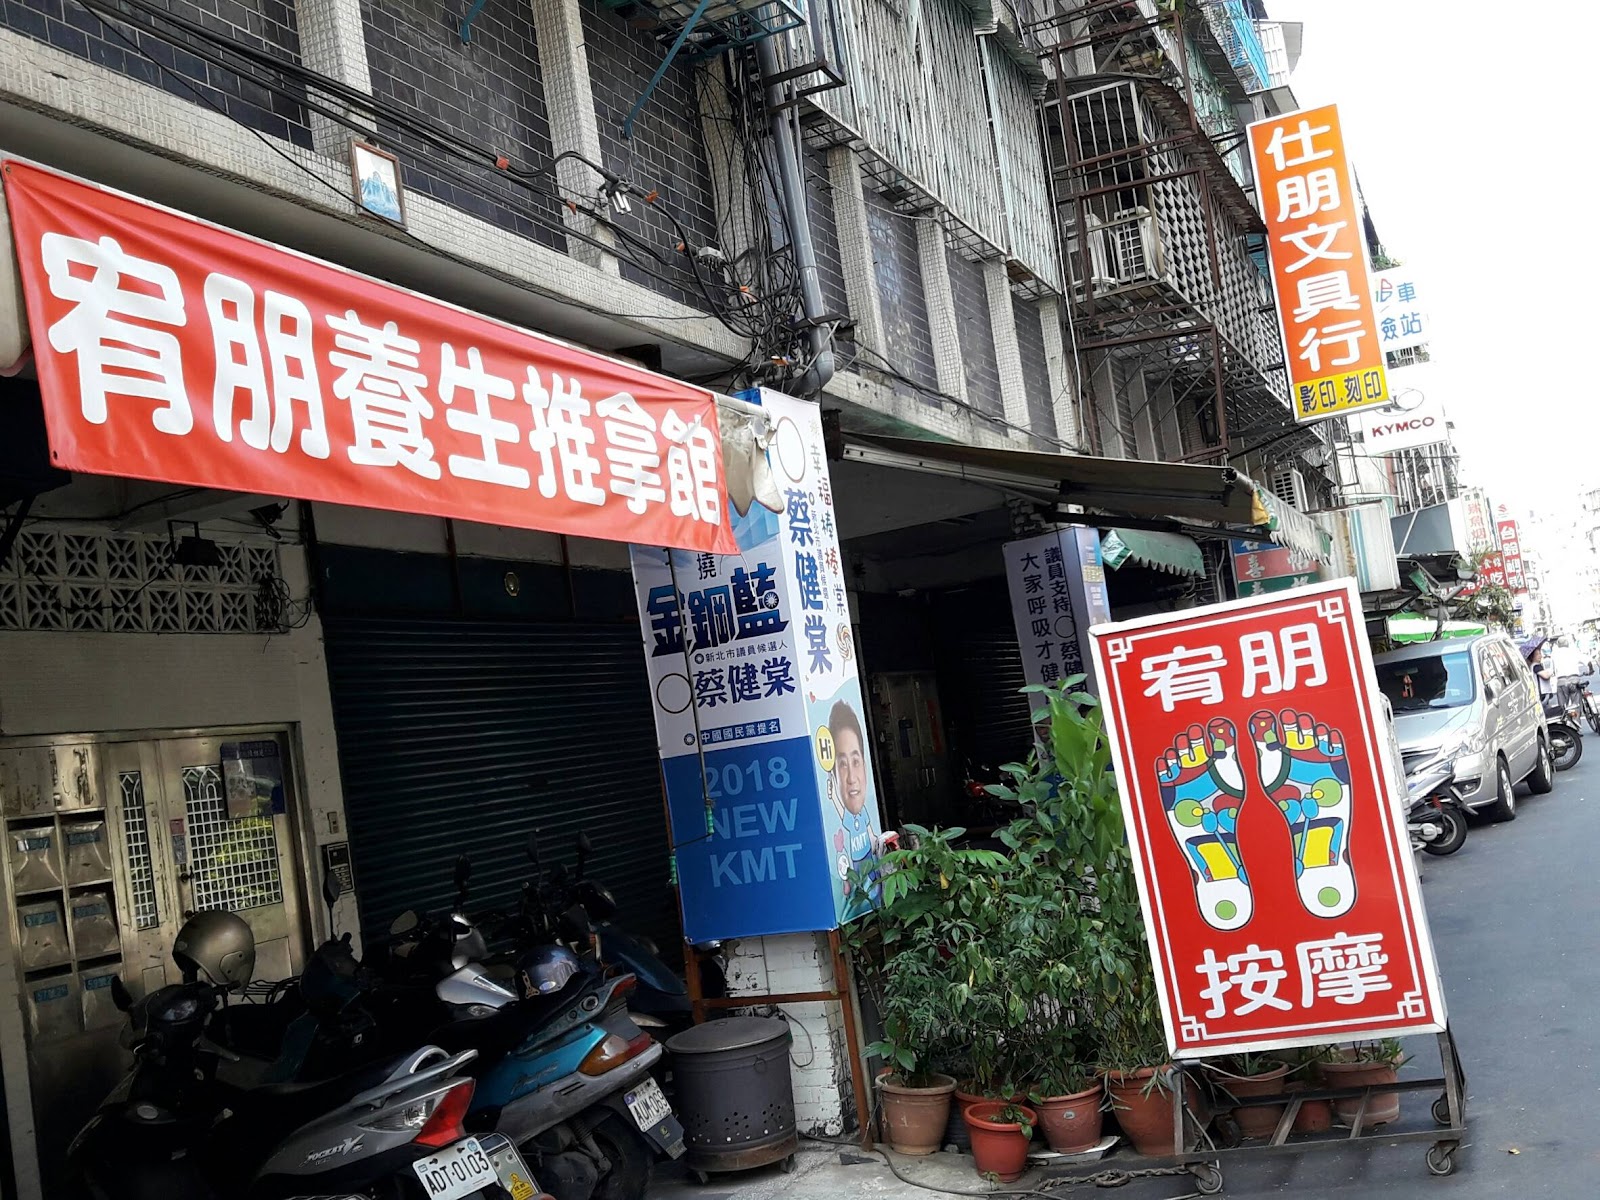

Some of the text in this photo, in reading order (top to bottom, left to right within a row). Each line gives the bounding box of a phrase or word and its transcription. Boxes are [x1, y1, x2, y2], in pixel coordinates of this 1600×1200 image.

[1265, 120, 1366, 373] 仕朋文具行
[41, 231, 719, 525] 宥朋養生推拿館
[1371, 416, 1435, 438] KYMCO
[784, 487, 833, 675] 蔡健棠
[1044, 546, 1071, 614] 議員支持
[647, 562, 789, 657] 金鋼藍
[1020, 553, 1061, 705] 大家呼吸才健
[705, 640, 788, 662] 新北市議員候選人
[1140, 622, 1328, 712] 宥朋
[694, 657, 796, 708] 蔡健棠
[701, 719, 780, 743] 中國國民黨提名
[819, 737, 833, 761] Hi
[703, 756, 791, 798] 2018
[704, 798, 798, 843] NEW
[851, 832, 868, 852] KMT
[710, 844, 803, 888] KMT
[1195, 931, 1393, 1019] 按摩
